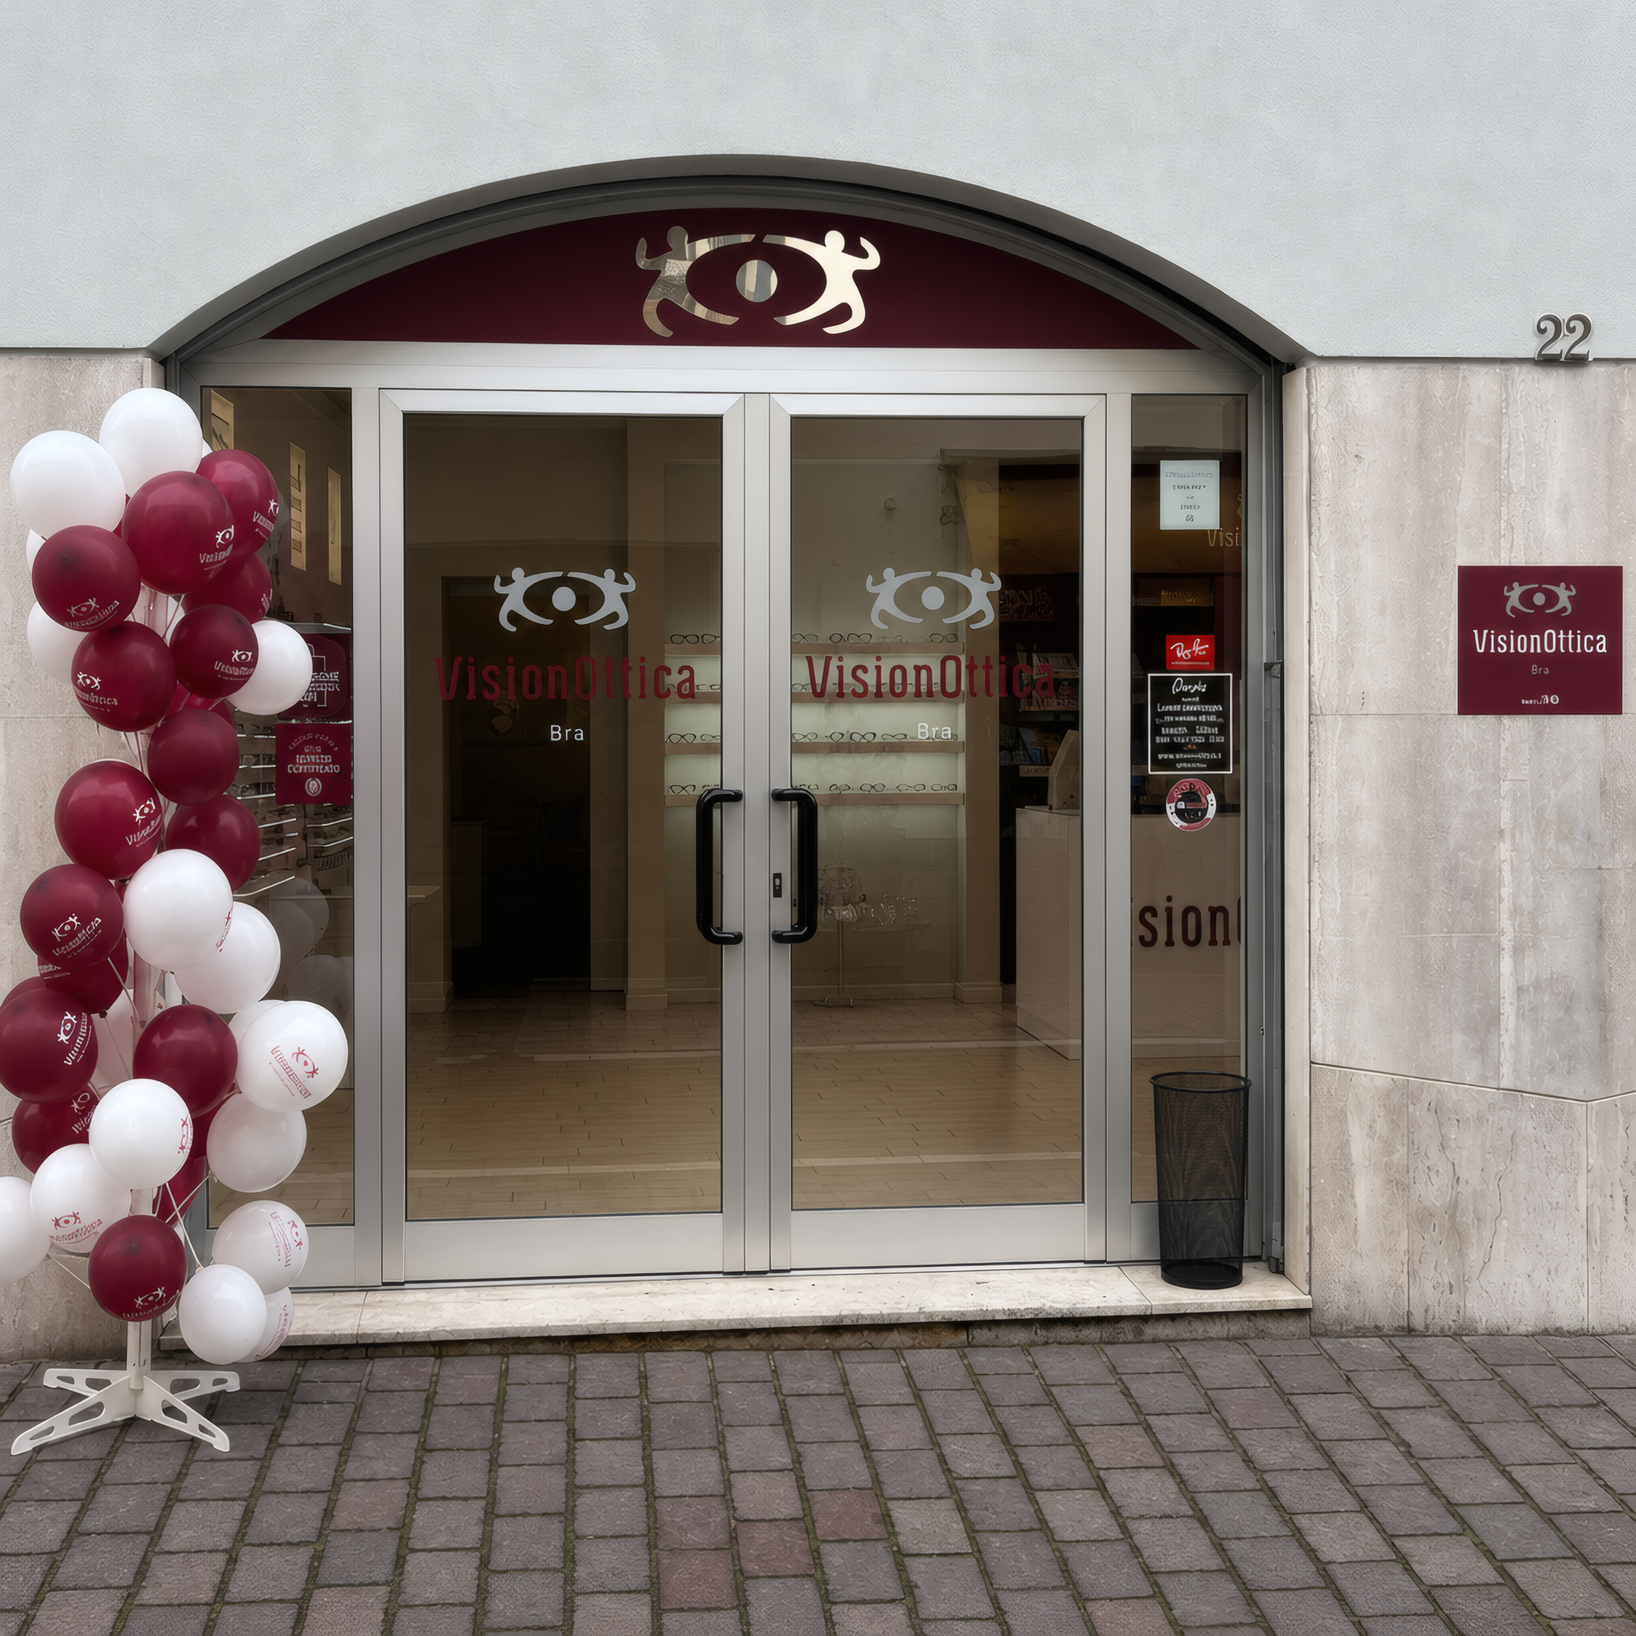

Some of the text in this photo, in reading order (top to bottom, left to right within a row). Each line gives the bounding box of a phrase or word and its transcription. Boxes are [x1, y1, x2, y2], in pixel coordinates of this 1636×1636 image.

[1536, 313, 1592, 362] 22
[1472, 629, 1608, 654] VisionOttica
[433, 655, 697, 701] VisionOttica
[804, 654, 1056, 699] VisionOttica
[1531, 664, 1550, 675] Bra
[550, 724, 585, 742] Bra
[916, 722, 952, 741] Bra
[1131, 895, 1242, 948] sion
